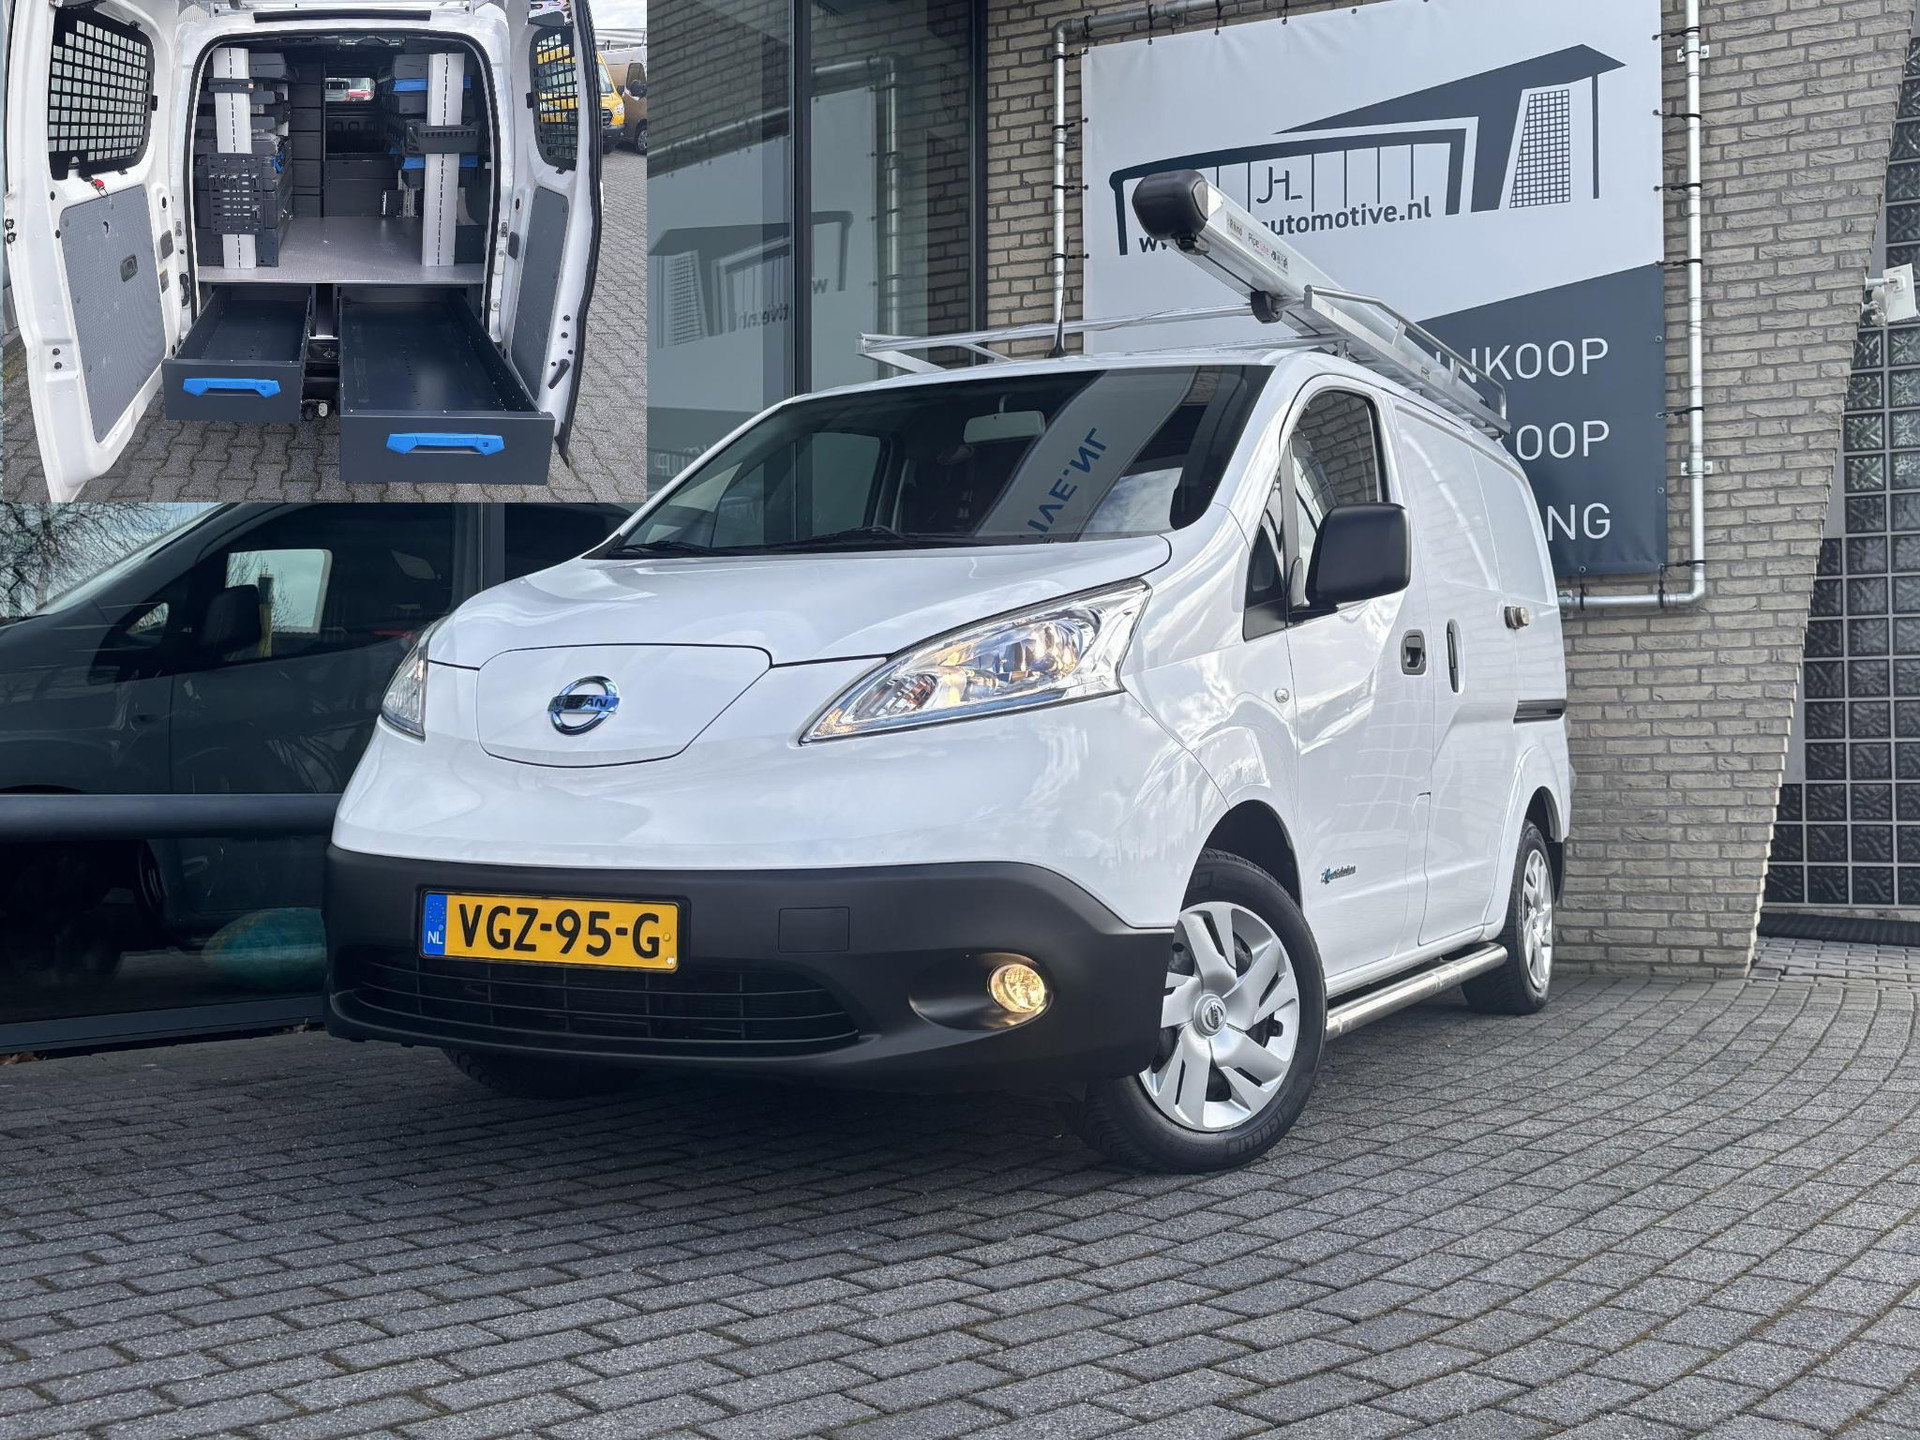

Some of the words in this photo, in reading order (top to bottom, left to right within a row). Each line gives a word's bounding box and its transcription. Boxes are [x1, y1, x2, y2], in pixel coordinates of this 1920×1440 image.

[1547, 502, 1611, 542] NG
[427, 930, 444, 945] NL
[458, 903, 661, 959] VGZ-95-G
